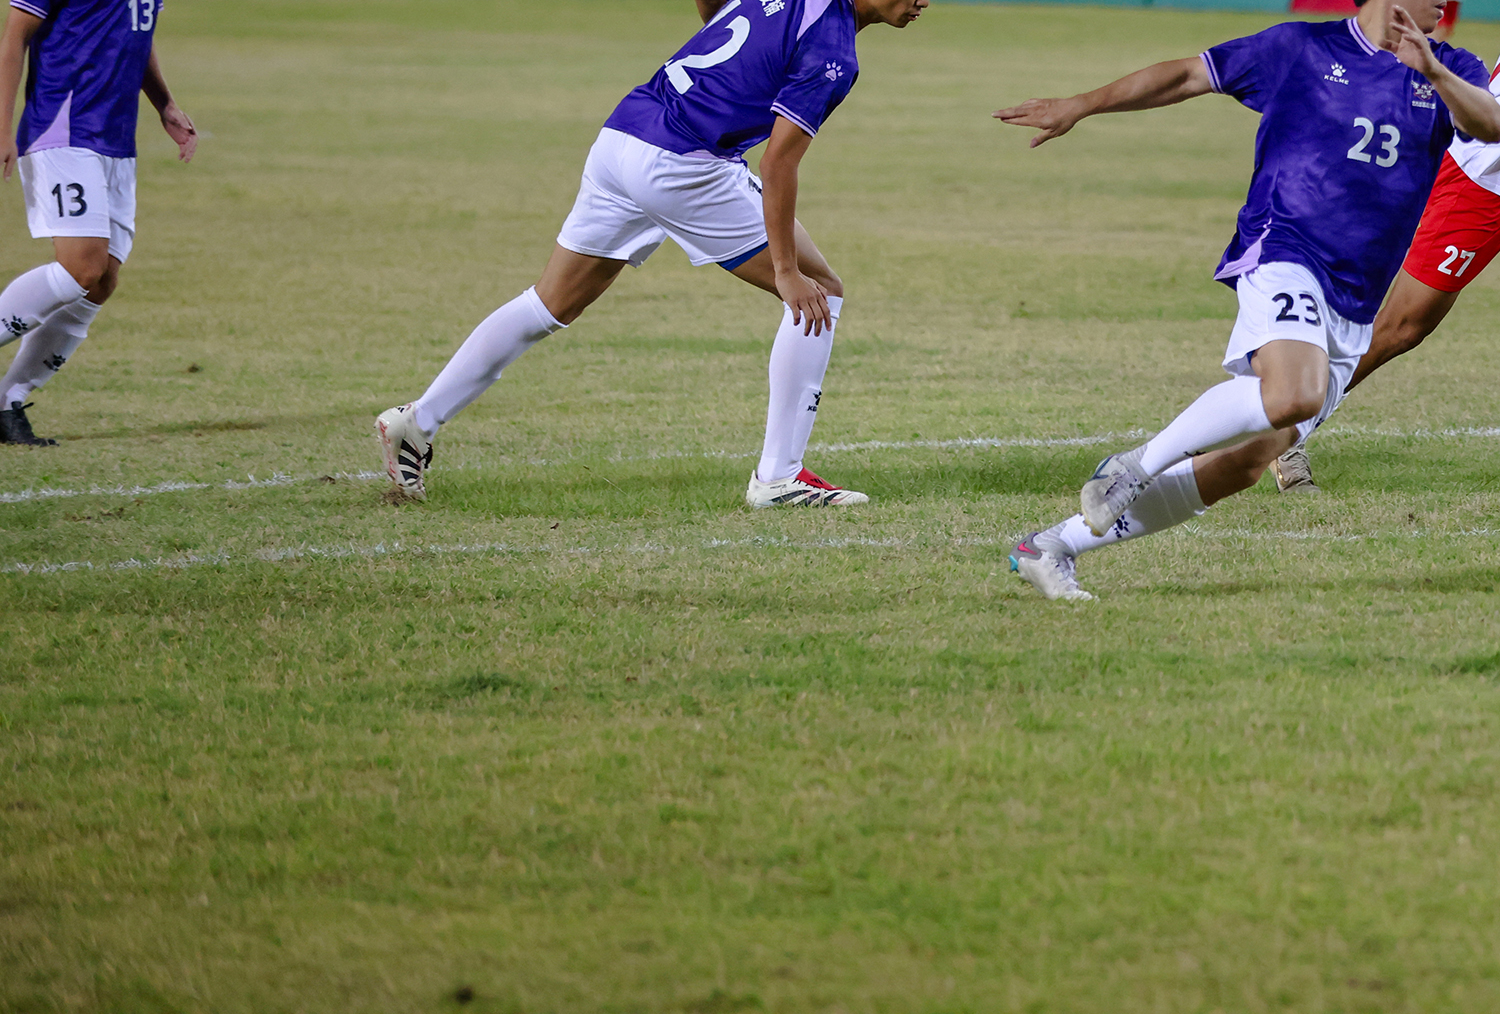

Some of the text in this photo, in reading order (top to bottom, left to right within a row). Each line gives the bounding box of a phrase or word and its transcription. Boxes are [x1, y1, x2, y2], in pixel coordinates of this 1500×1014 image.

[1323, 74, 1350, 86] KELME
[1346, 117, 1401, 168] 23
[51, 183, 88, 218] 13
[1437, 245, 1477, 278] 27
[1271, 292, 1322, 327] 23
